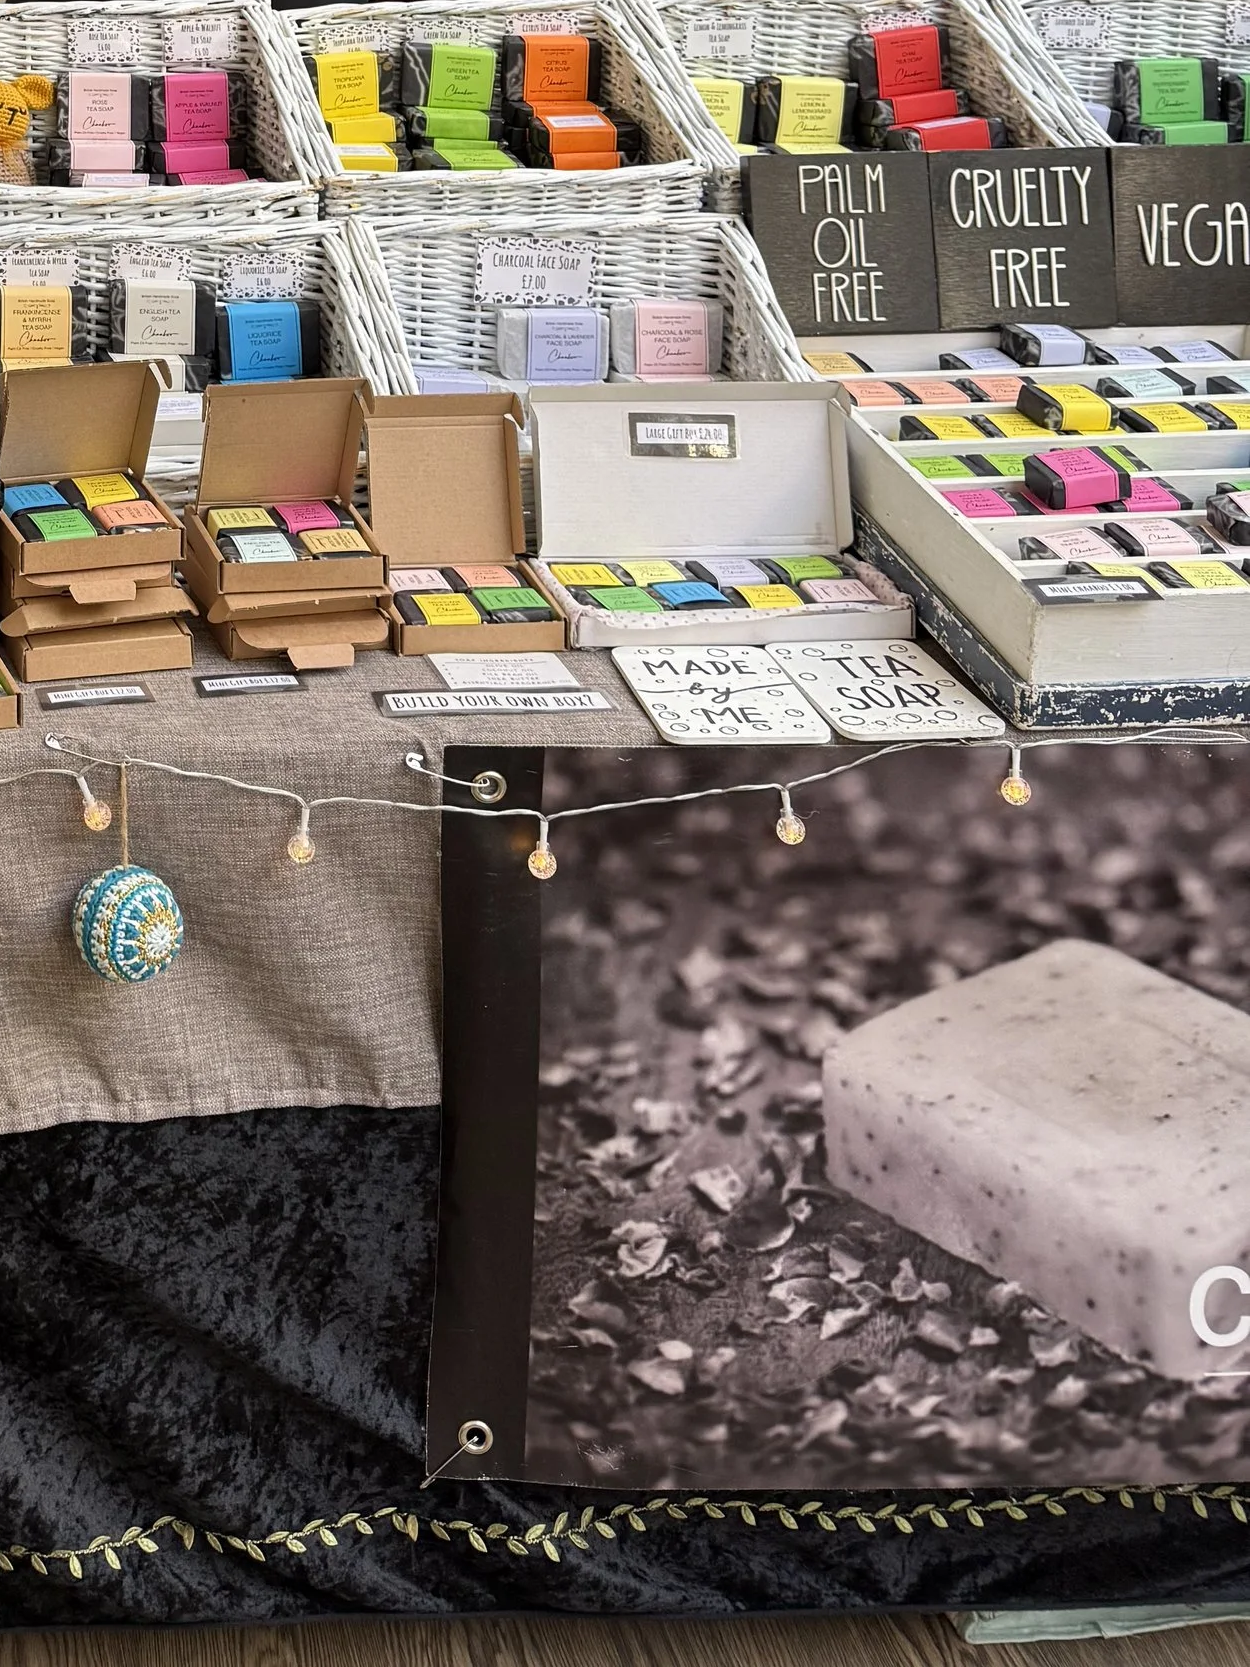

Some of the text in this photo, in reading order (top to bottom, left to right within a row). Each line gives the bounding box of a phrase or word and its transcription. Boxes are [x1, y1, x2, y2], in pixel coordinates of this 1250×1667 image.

[798, 163, 886, 215] PALM
[950, 165, 1092, 229] CRUELTY
[813, 217, 878, 269] OIL
[159, 259, 172, 269] SOAP
[239, 265, 265, 275] LIQUORICE
[275, 265, 288, 275] SOAP
[492, 252, 581, 272] CHARCOAL FACE SOAP
[37, 269, 50, 278] SOAP
[989, 246, 1071, 309] FREE
[812, 271, 888, 323] FREE
[18, 330, 56, 347] Chaaboo
[141, 324, 179, 341] Chaaboo
[250, 339, 264, 347] TEA
[645, 426, 665, 439] LARGE
[667, 426, 683, 440] GIFT
[642, 659, 757, 677] MADE
[821, 654, 924, 679] TEA
[391, 694, 596, 710] BUILD YOUR OWN BOX?
[836, 683, 946, 711] SOAP
[695, 706, 769, 725] ME
